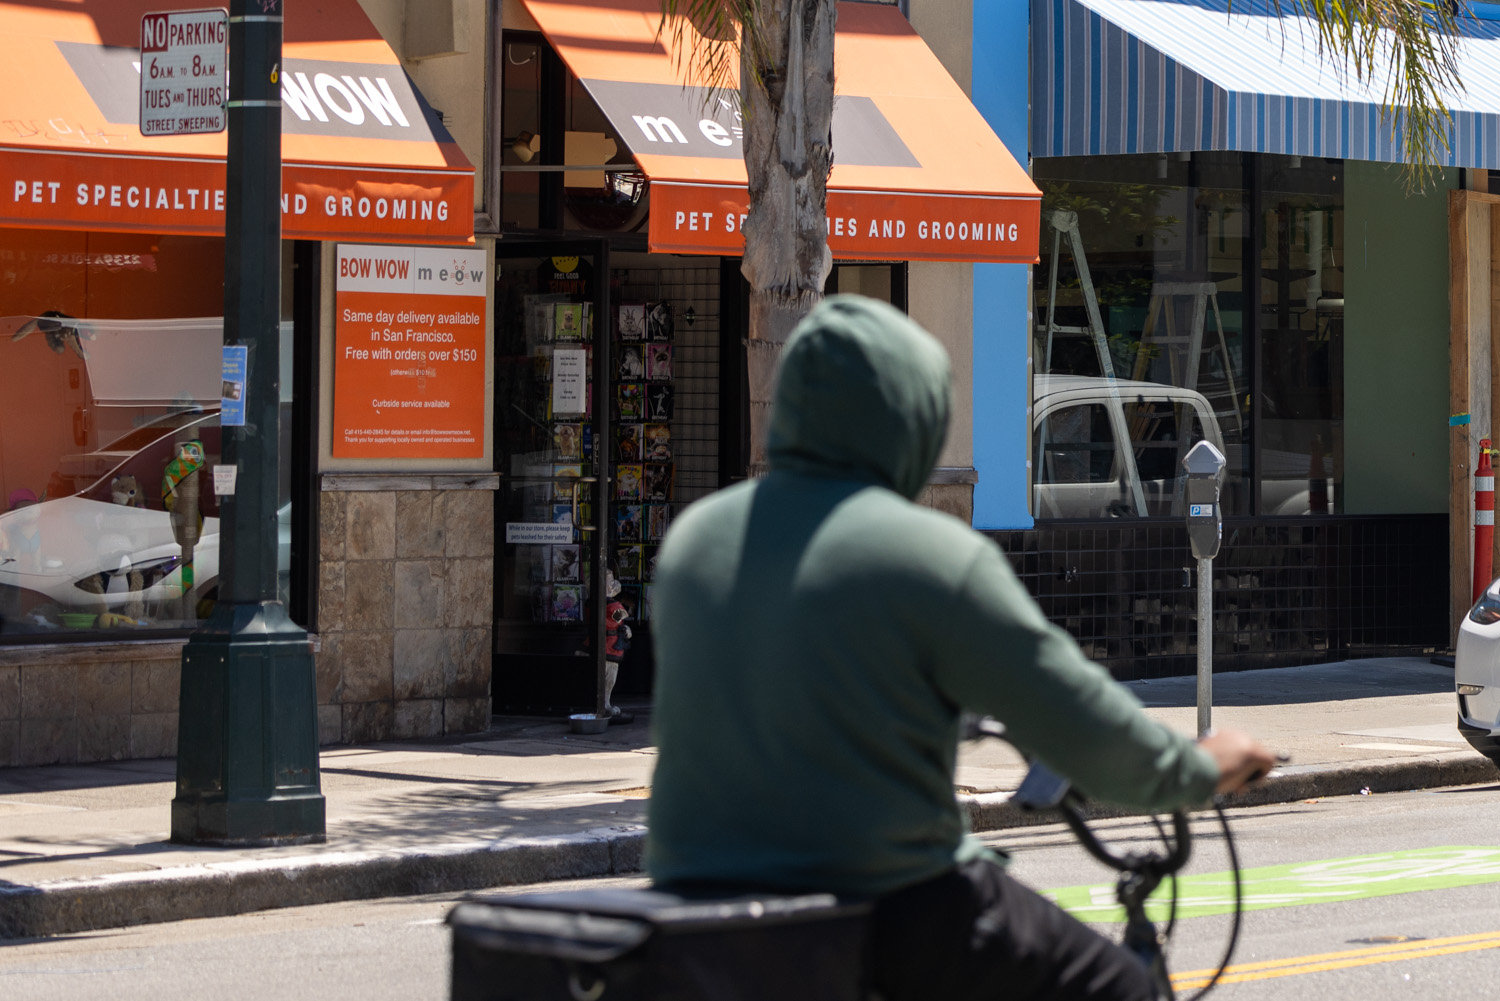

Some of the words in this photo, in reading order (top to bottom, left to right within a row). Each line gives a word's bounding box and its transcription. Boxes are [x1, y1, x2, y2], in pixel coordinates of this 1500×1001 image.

[144, 17, 167, 48] NO
[170, 21, 225, 46] PARKING
[145, 89, 170, 109] TUES
[173, 93, 184, 103] AND
[187, 87, 222, 107] THURS
[281, 71, 410, 127] WOW
[146, 118, 175, 131] STREET
[178, 116, 219, 130] SWEEPING
[14, 180, 61, 203] PET
[76, 183, 225, 211] SPECIALTIE
[280, 193, 307, 214] ND
[325, 195, 448, 221] GROOMING
[675, 211, 713, 231] PET
[868, 219, 906, 238] AND
[918, 221, 1018, 242] GROOMING
[340, 258, 371, 279] BOW
[375, 259, 410, 279] WOW
[418, 266, 483, 283] meow
[343, 309, 373, 322] Same
[376, 310, 394, 325] day
[397, 310, 435, 326] delivery
[437, 312, 480, 325] available
[371, 329, 380, 341] in
[383, 329, 403, 342] San
[406, 330, 456, 343] Francisco.
[346, 347, 368, 360] Free
[371, 348, 392, 360] with
[394, 348, 426, 360] orders
[429, 350, 450, 361] over
[453, 348, 477, 362] $150
[372, 399, 399, 408] Curbside
[401, 400, 422, 408] service
[424, 400, 450, 408] available
